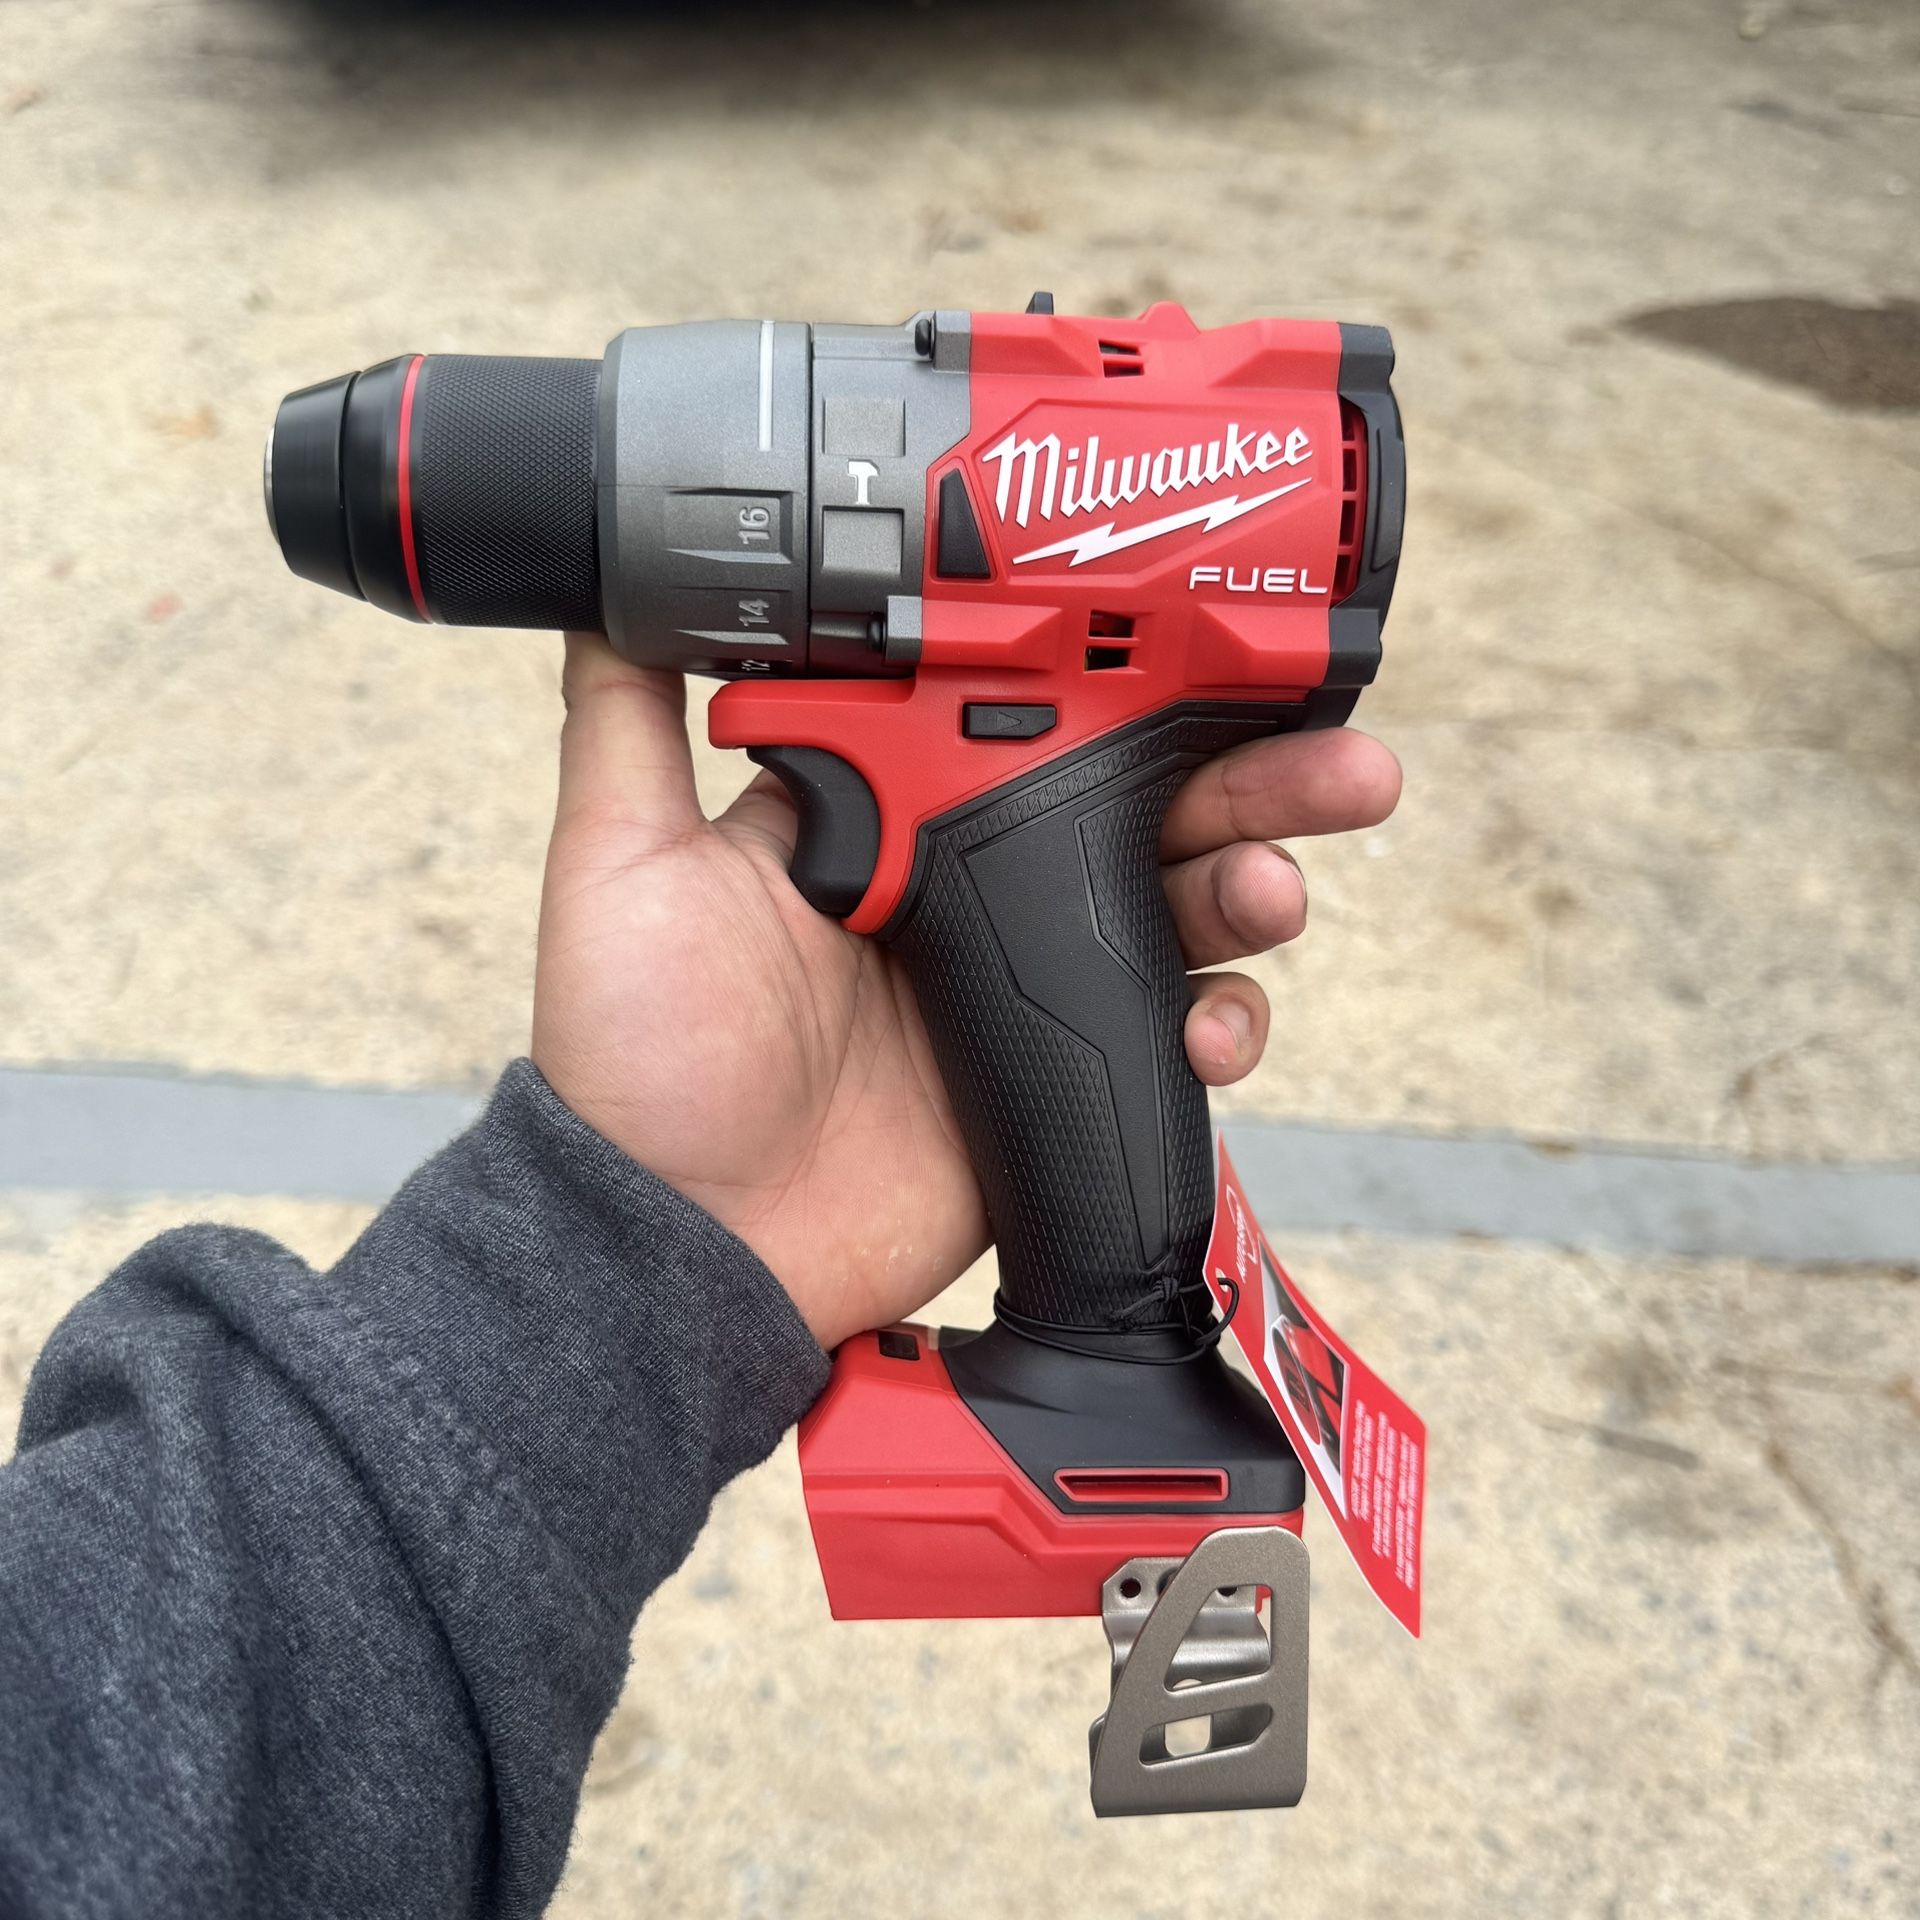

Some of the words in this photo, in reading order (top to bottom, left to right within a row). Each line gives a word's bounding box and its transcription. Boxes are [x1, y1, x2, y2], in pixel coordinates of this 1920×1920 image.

[982, 424, 1313, 529] Milwaukee
[738, 506, 771, 545] 16
[1189, 566, 1328, 594] FUEL
[738, 599, 770, 627] 14
